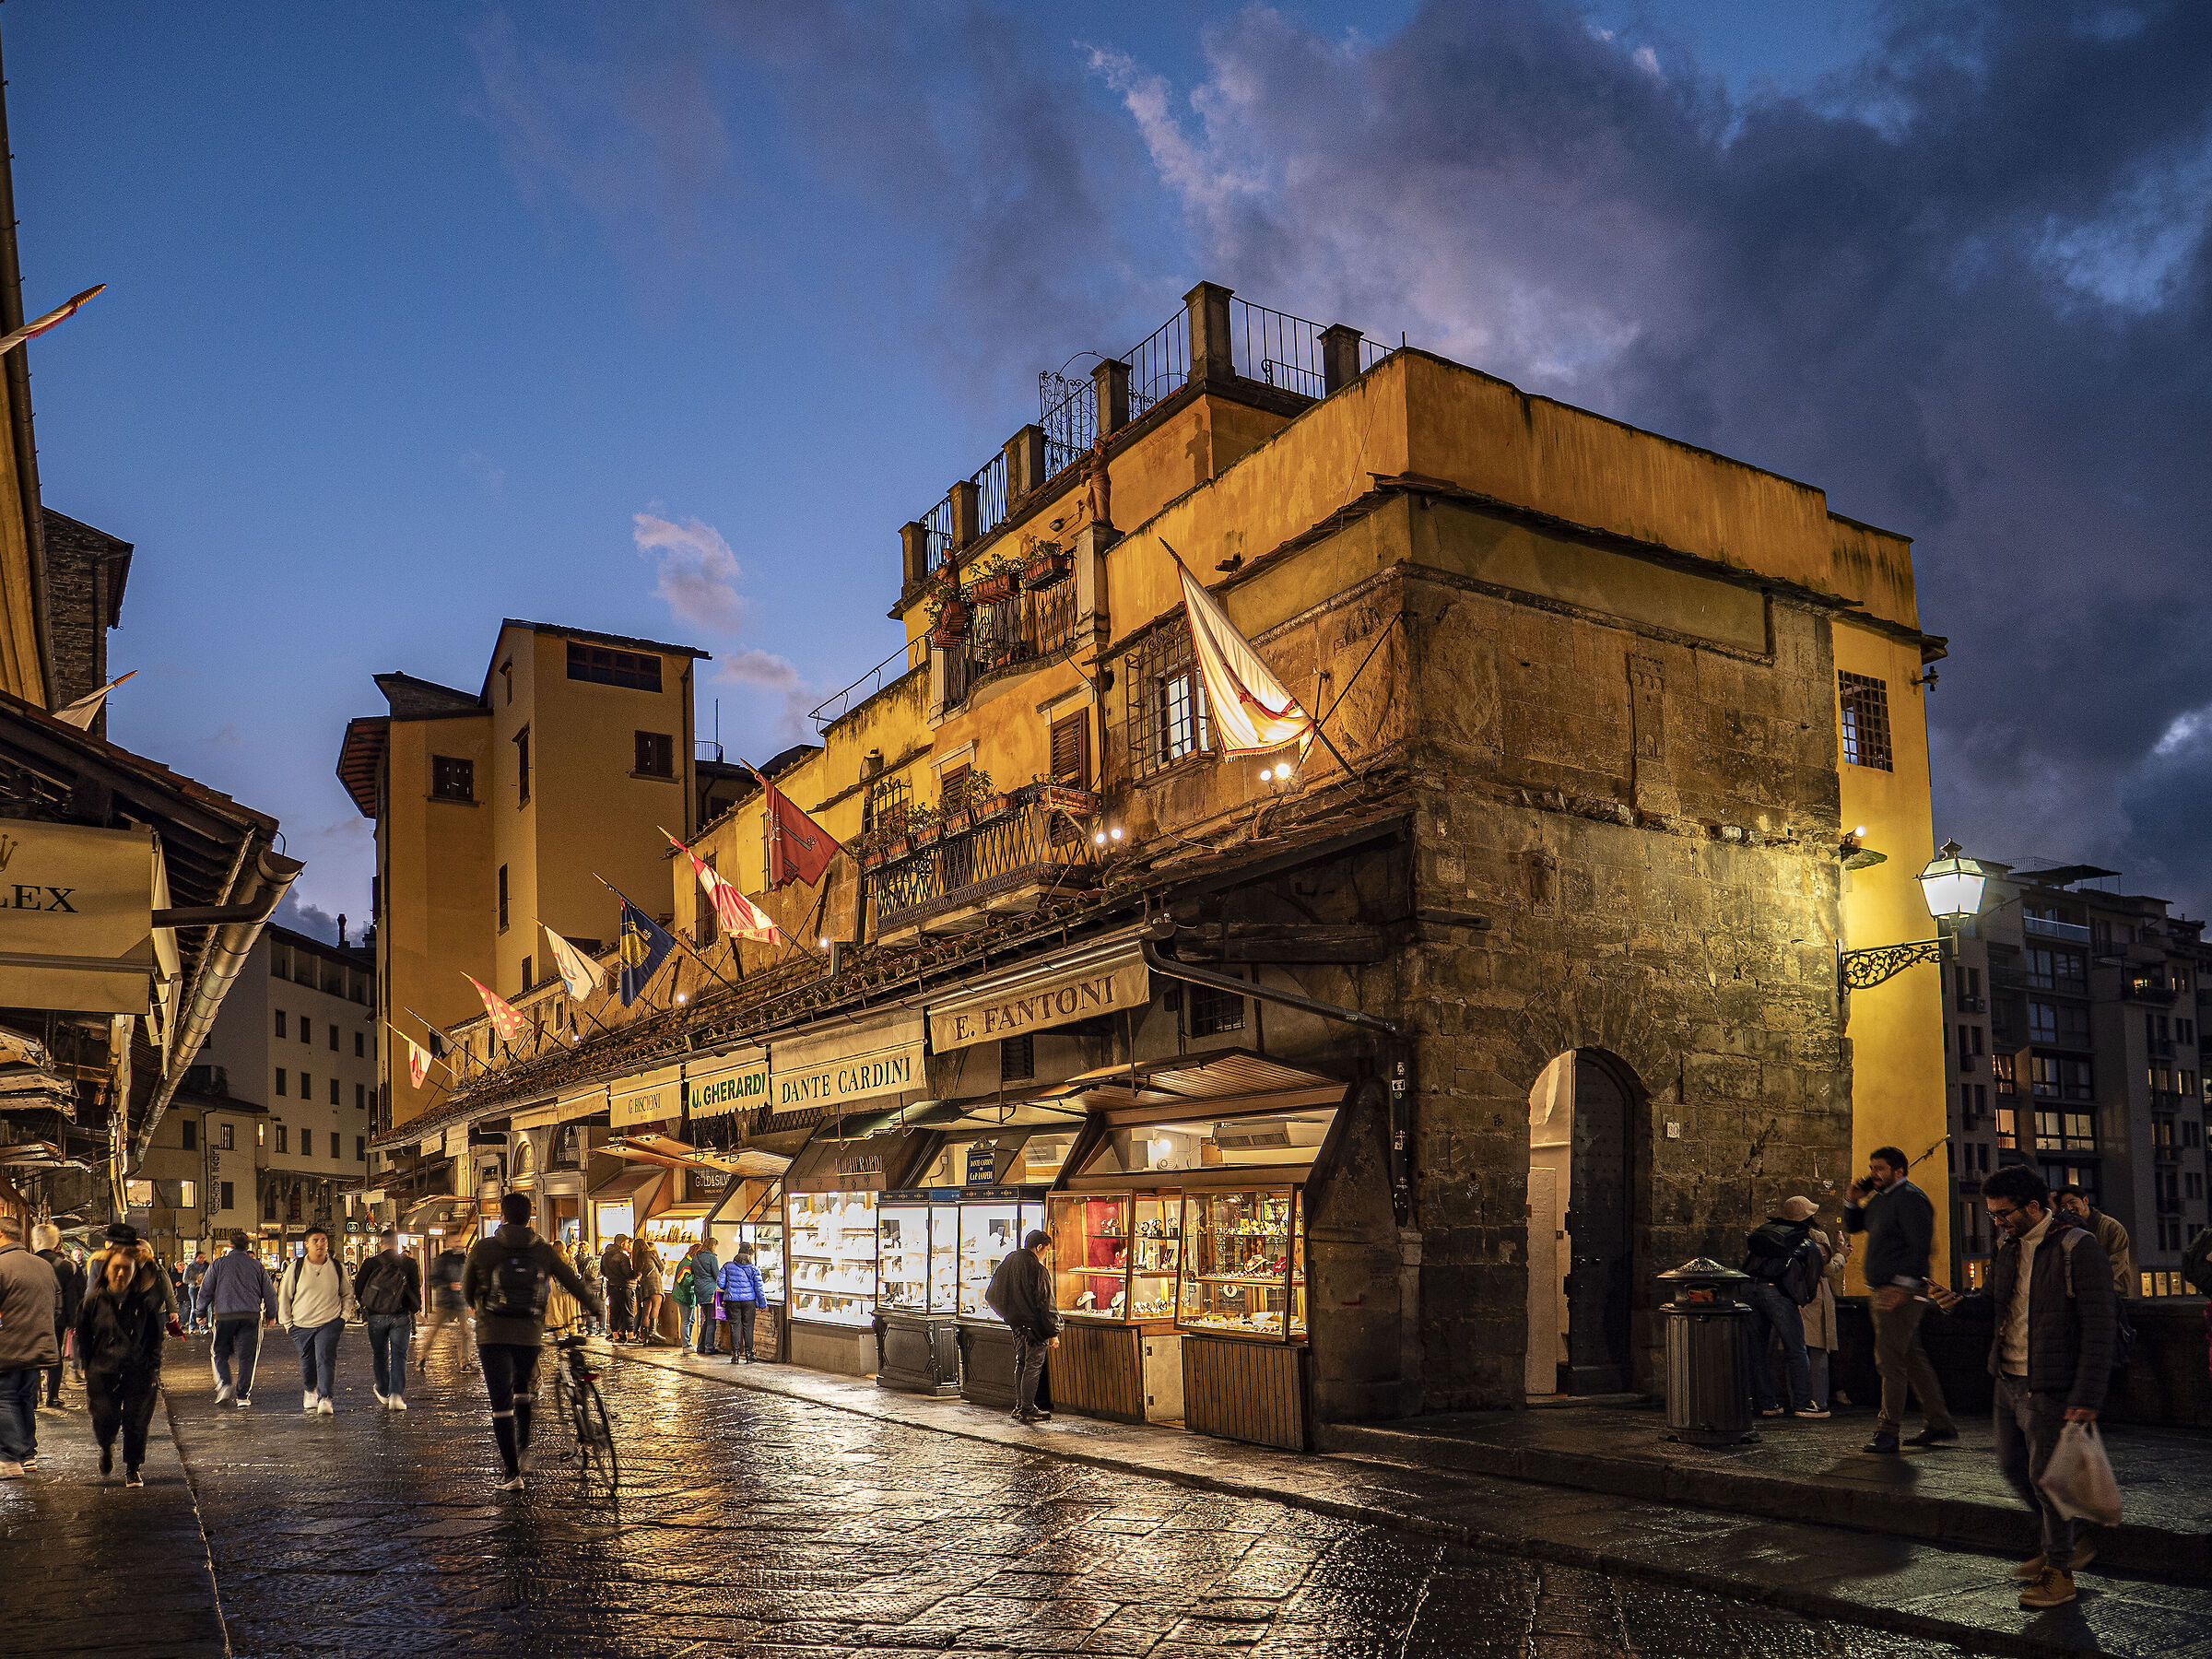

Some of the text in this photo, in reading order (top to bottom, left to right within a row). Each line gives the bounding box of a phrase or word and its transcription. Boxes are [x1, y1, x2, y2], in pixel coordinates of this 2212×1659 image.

[0, 884, 79, 913] EX
[954, 974, 1115, 1041] E. FANTONI
[692, 1072, 766, 1109] U. GHERARDI
[782, 1057, 911, 1104] DANTE CARDINI
